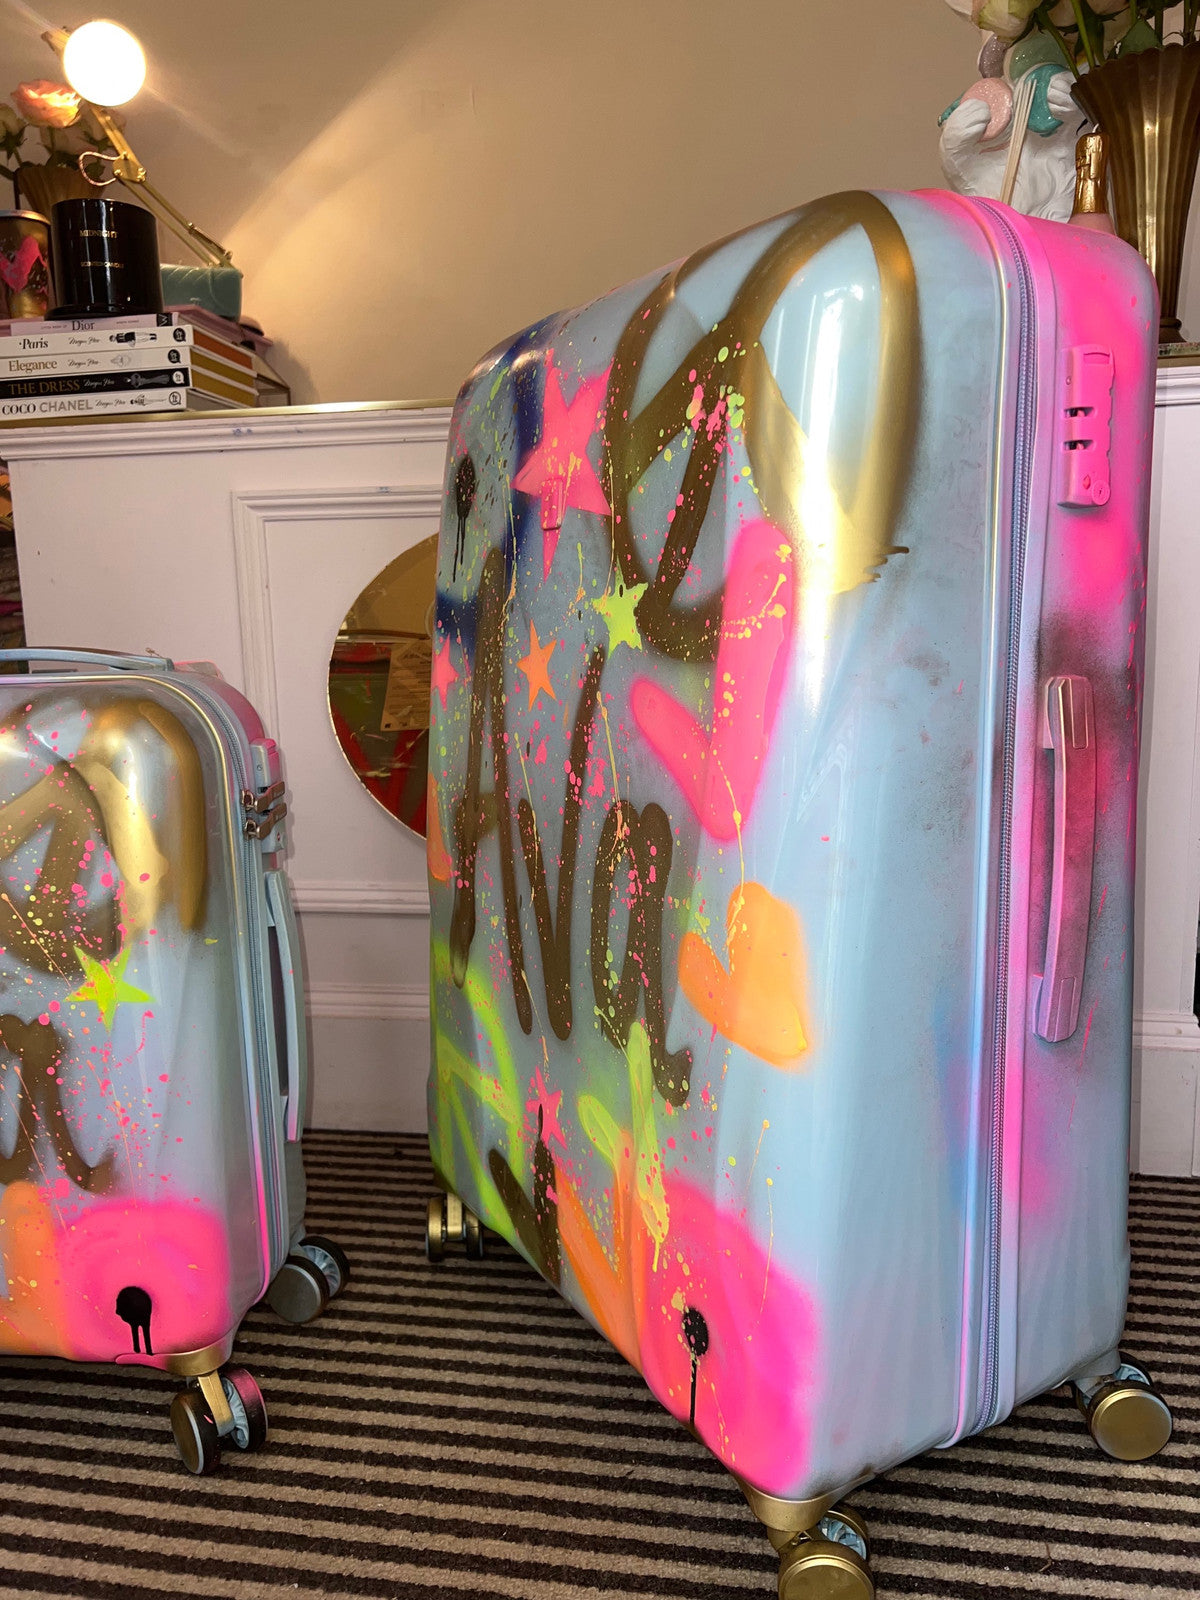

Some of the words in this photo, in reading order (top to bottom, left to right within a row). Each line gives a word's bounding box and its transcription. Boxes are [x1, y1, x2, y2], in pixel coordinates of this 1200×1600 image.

[79, 230, 118, 238] MIDNIGHT
[72, 320, 95, 330] Dior
[8, 360, 58, 373] Elegance
[8, 382, 36, 395] THE
[39, 379, 81, 393] DRESS
[2, 403, 36, 415] COCO
[39, 399, 94, 413] CHANEL
